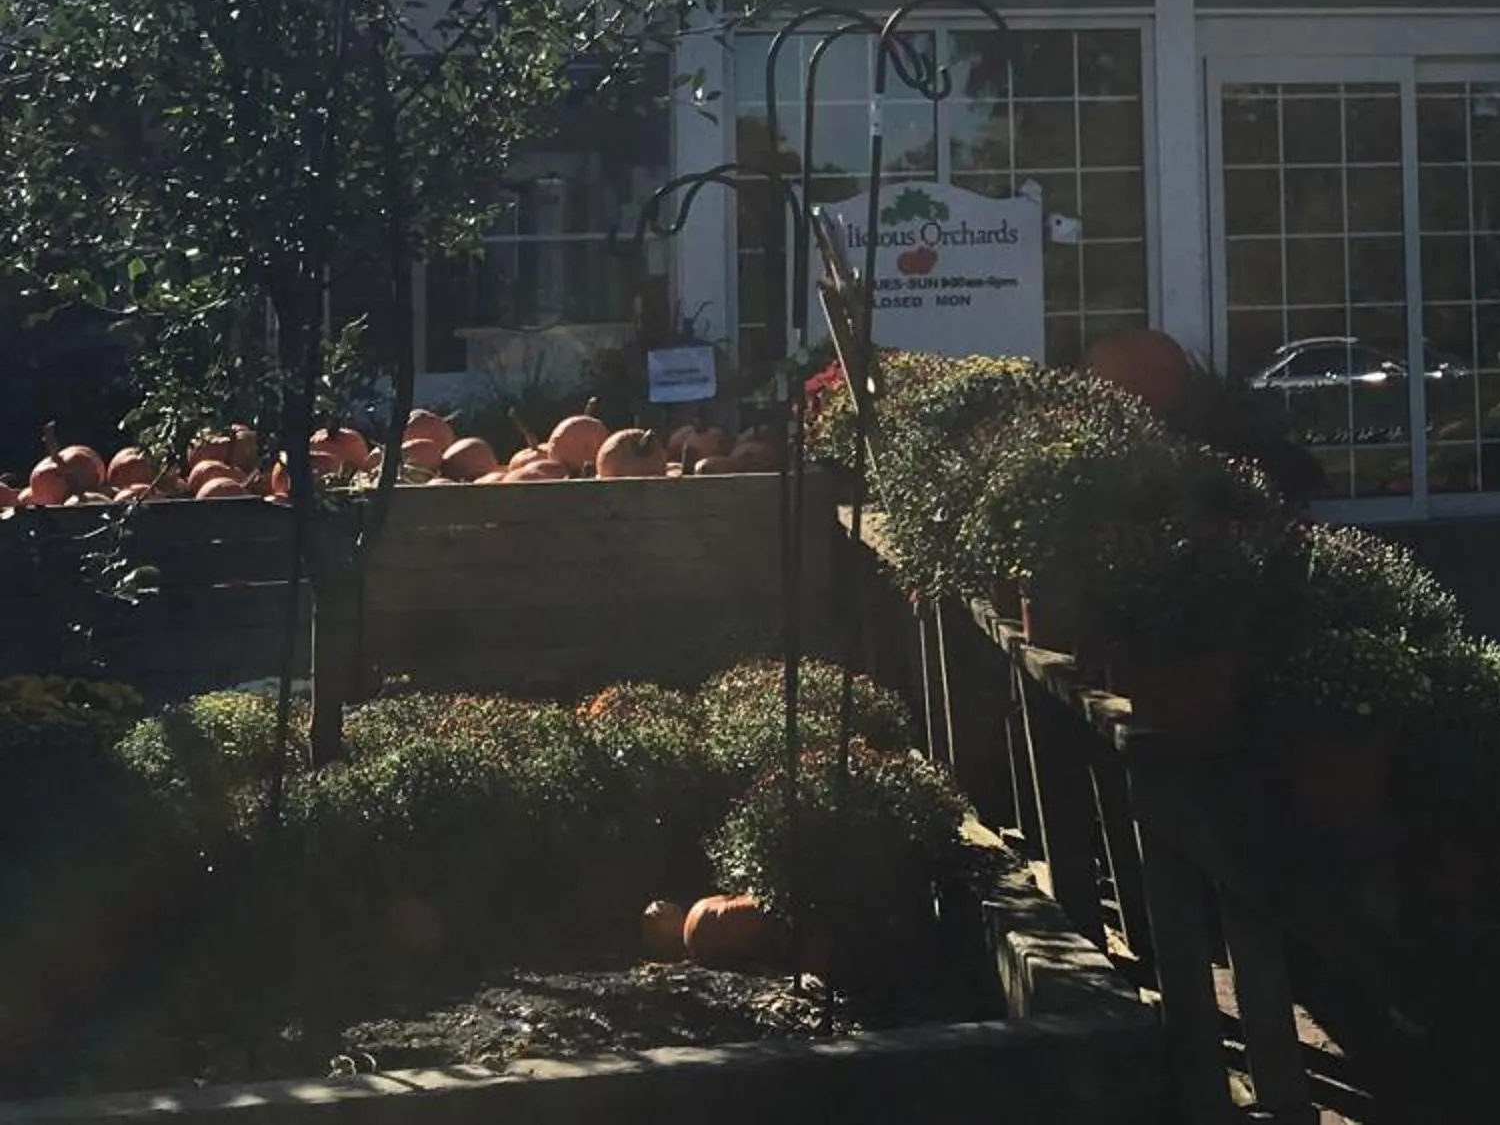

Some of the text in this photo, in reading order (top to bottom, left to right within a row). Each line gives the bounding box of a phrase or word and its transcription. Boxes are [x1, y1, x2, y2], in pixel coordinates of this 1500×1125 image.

[920, 219, 1019, 248] Orchards
[872, 277, 938, 291] UES-SUN
[871, 294, 971, 309] LOSED MON
